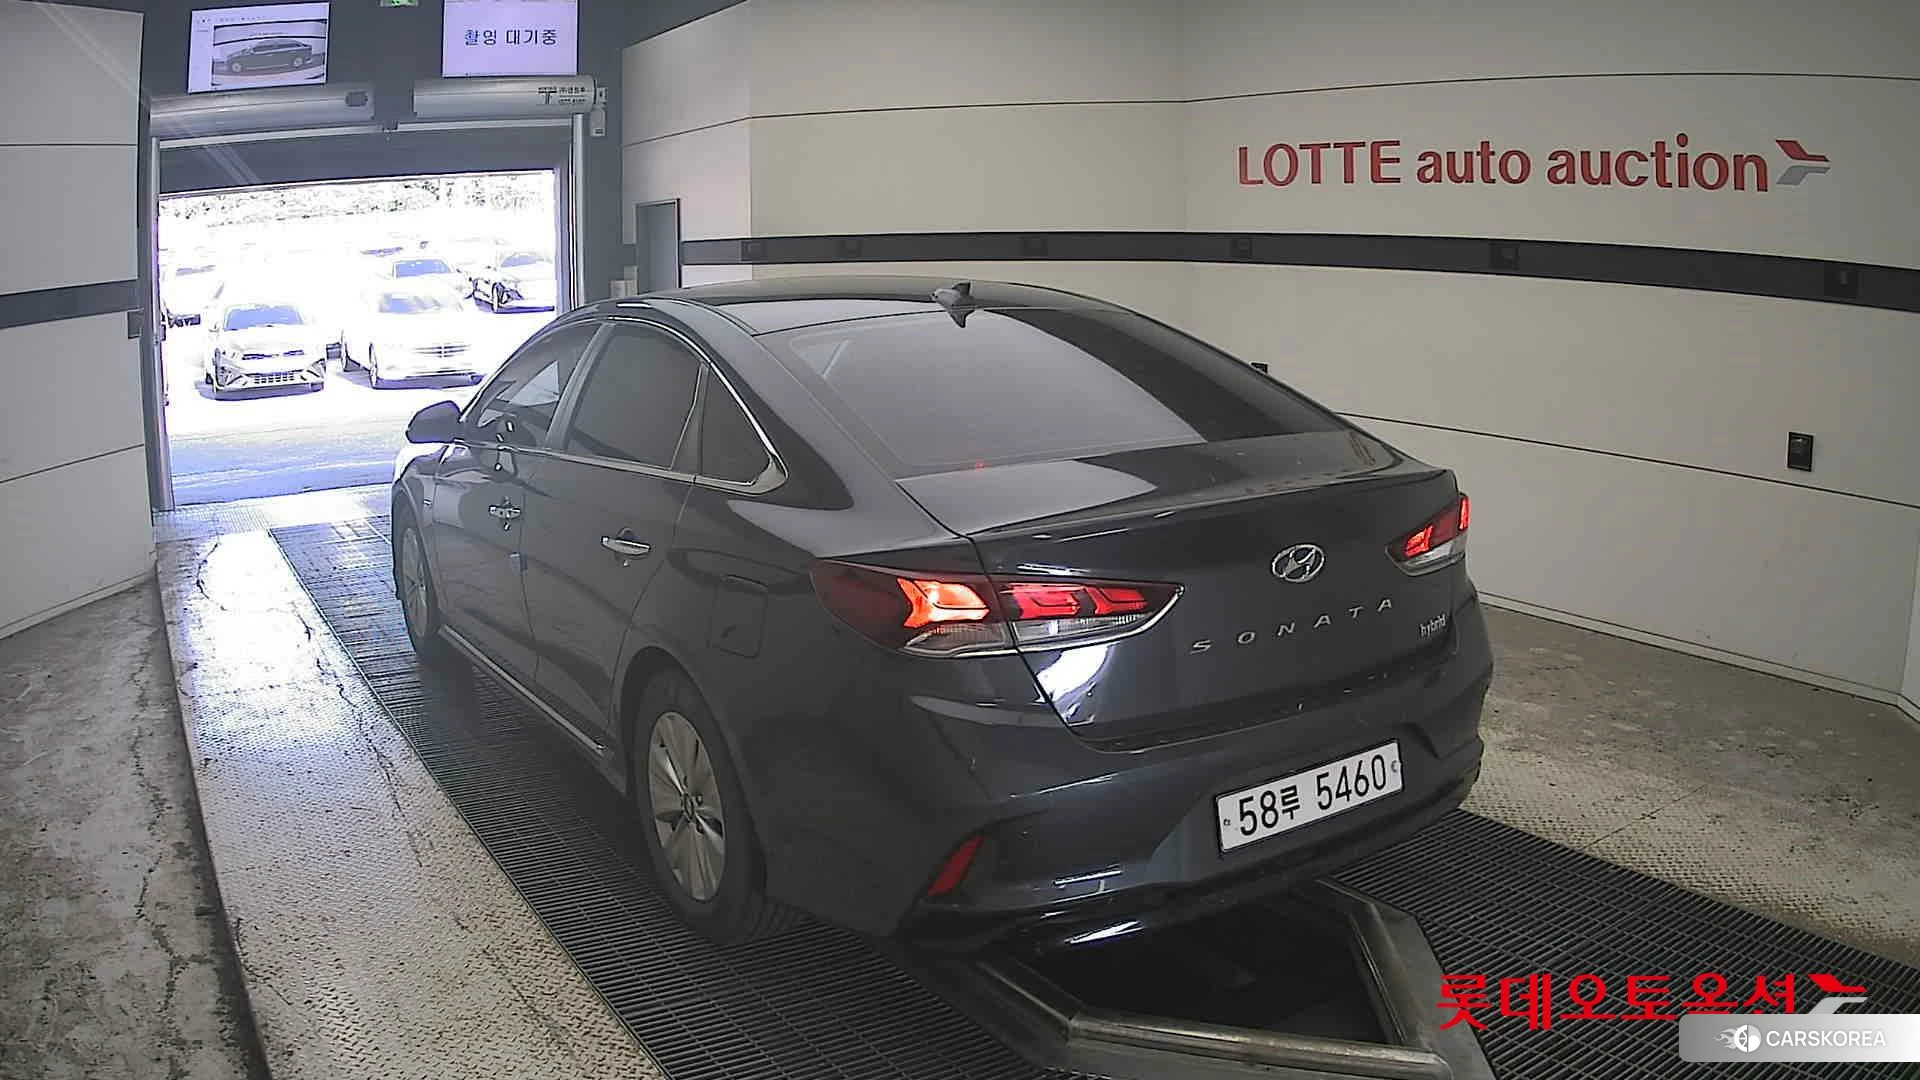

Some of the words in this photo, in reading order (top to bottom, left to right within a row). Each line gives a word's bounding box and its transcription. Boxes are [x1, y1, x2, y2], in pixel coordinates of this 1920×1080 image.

[505, 29, 558, 46] 대기중
[1238, 140, 1401, 187] LOTTE
[1416, 140, 1532, 185] auto
[1547, 133, 1769, 192] auction
[1190, 598, 1393, 654] SONATA
[1238, 784, 1301, 836] 58루
[1315, 754, 1387, 811] 5460
